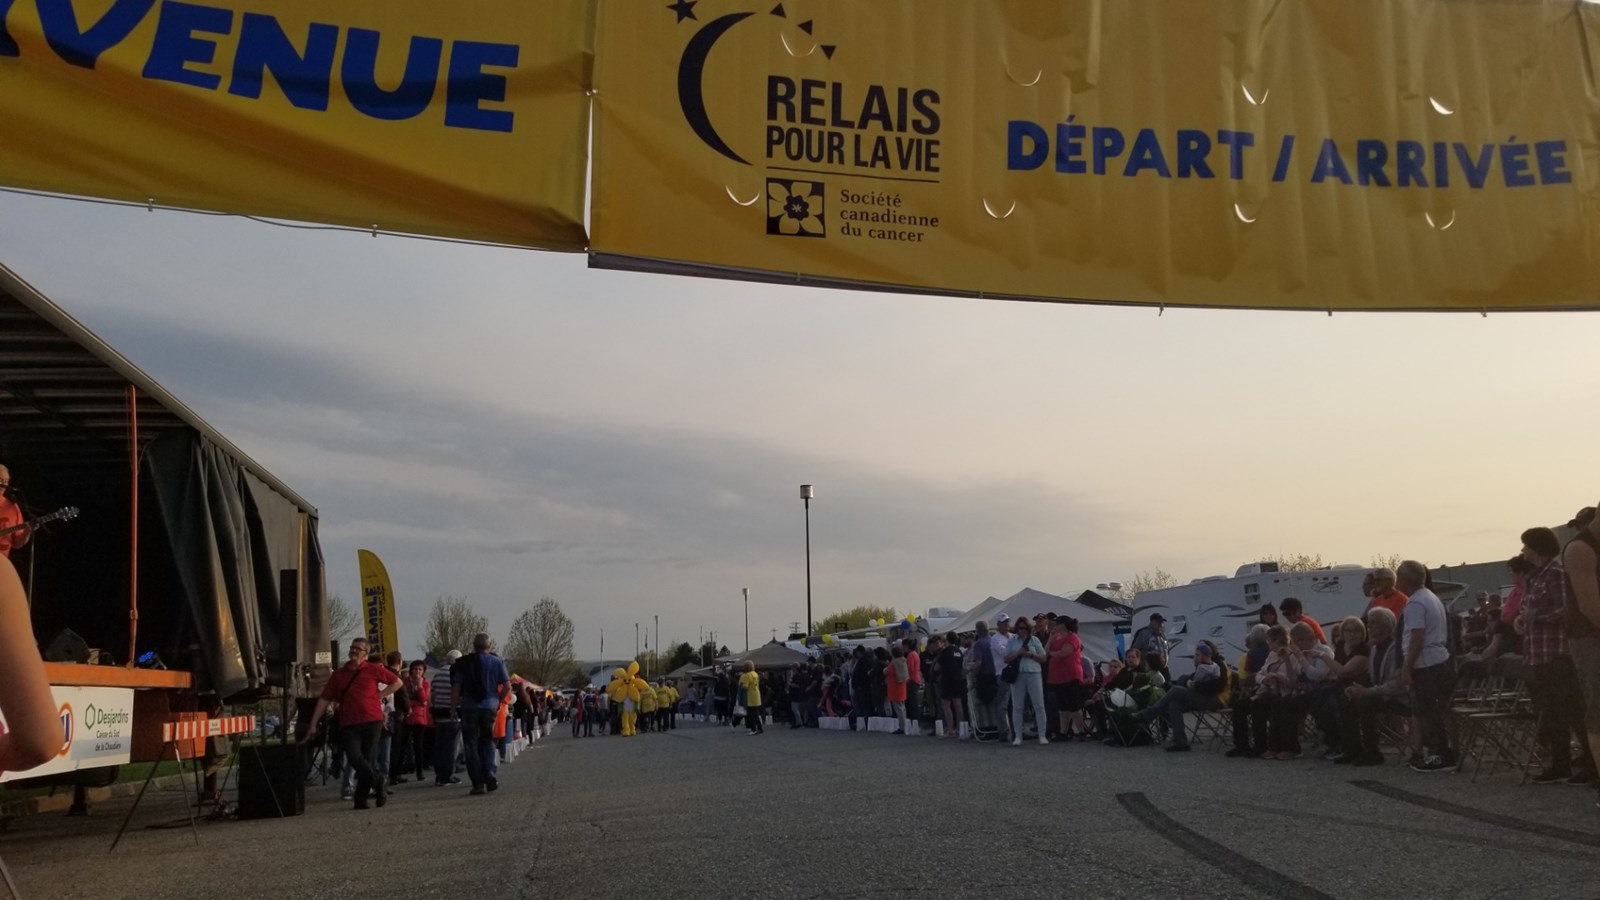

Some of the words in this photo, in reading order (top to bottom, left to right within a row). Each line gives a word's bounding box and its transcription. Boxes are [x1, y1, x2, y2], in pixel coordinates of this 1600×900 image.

[0, 0, 519, 132] VENUE
[766, 75, 941, 136] RELAIS
[766, 125, 845, 166] POUR
[854, 133, 892, 170] LA
[896, 137, 941, 173] VIE
[1007, 114, 1255, 181] DÉPART
[1271, 134, 1295, 182] /
[1310, 135, 1572, 189] ARRIVÉE
[839, 208, 939, 228] canadienne
[840, 188, 902, 208] Société
[840, 222, 862, 237] du
[868, 227, 924, 243] cancer
[366, 587, 380, 653] SEMBLE
[98, 708, 129, 727] Desjardins
